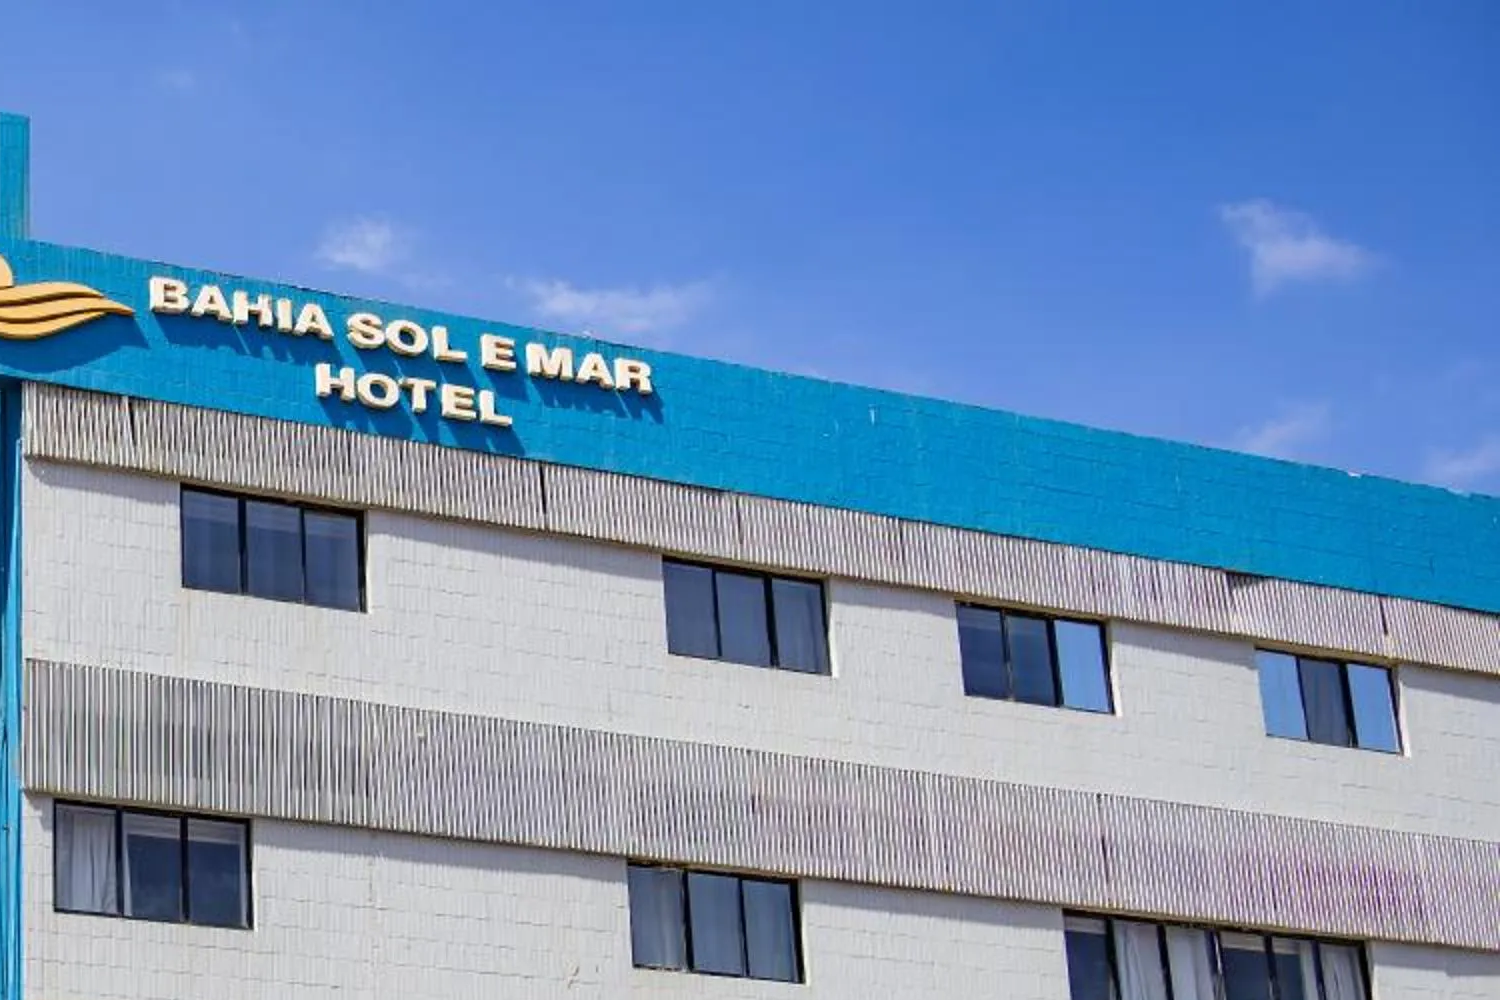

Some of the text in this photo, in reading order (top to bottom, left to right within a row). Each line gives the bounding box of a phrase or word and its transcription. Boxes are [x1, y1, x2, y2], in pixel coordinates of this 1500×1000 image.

[149, 276, 653, 394] BAHIA SOL E MAR
[315, 362, 513, 427] HOTEL
